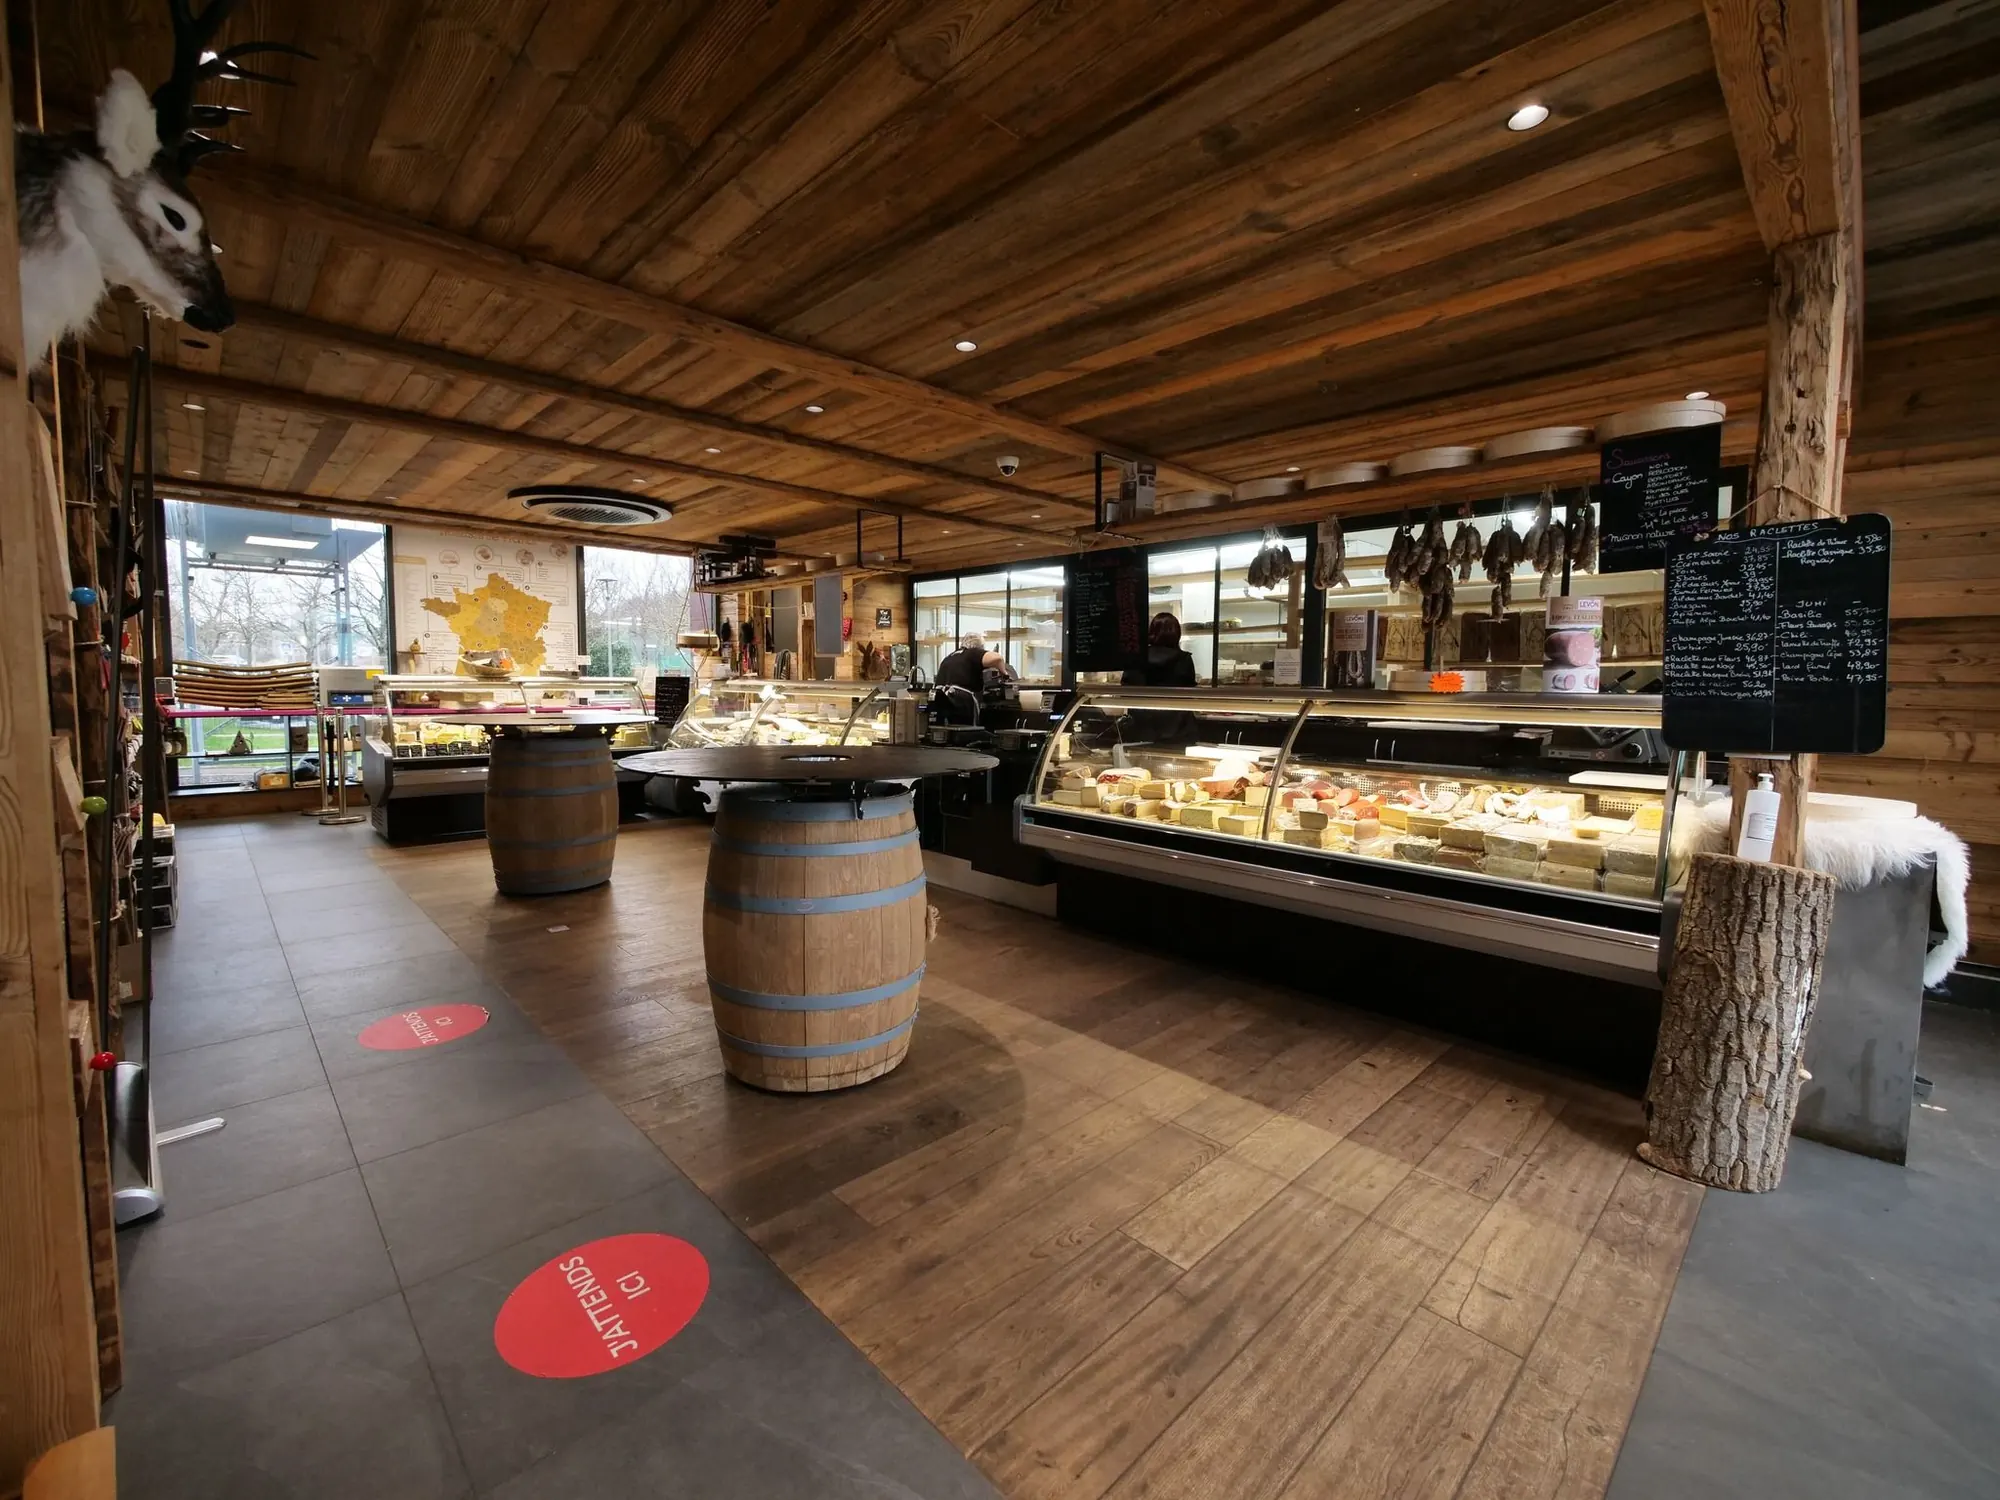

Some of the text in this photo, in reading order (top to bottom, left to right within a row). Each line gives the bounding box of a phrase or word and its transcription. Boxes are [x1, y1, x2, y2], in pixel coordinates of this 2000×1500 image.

[1612, 473, 1643, 489] Cayon
[1750, 522, 1819, 537] RACLETTES
[616, 1270, 651, 1300] ICI
[559, 1255, 638, 1358] J'ATTENDS
